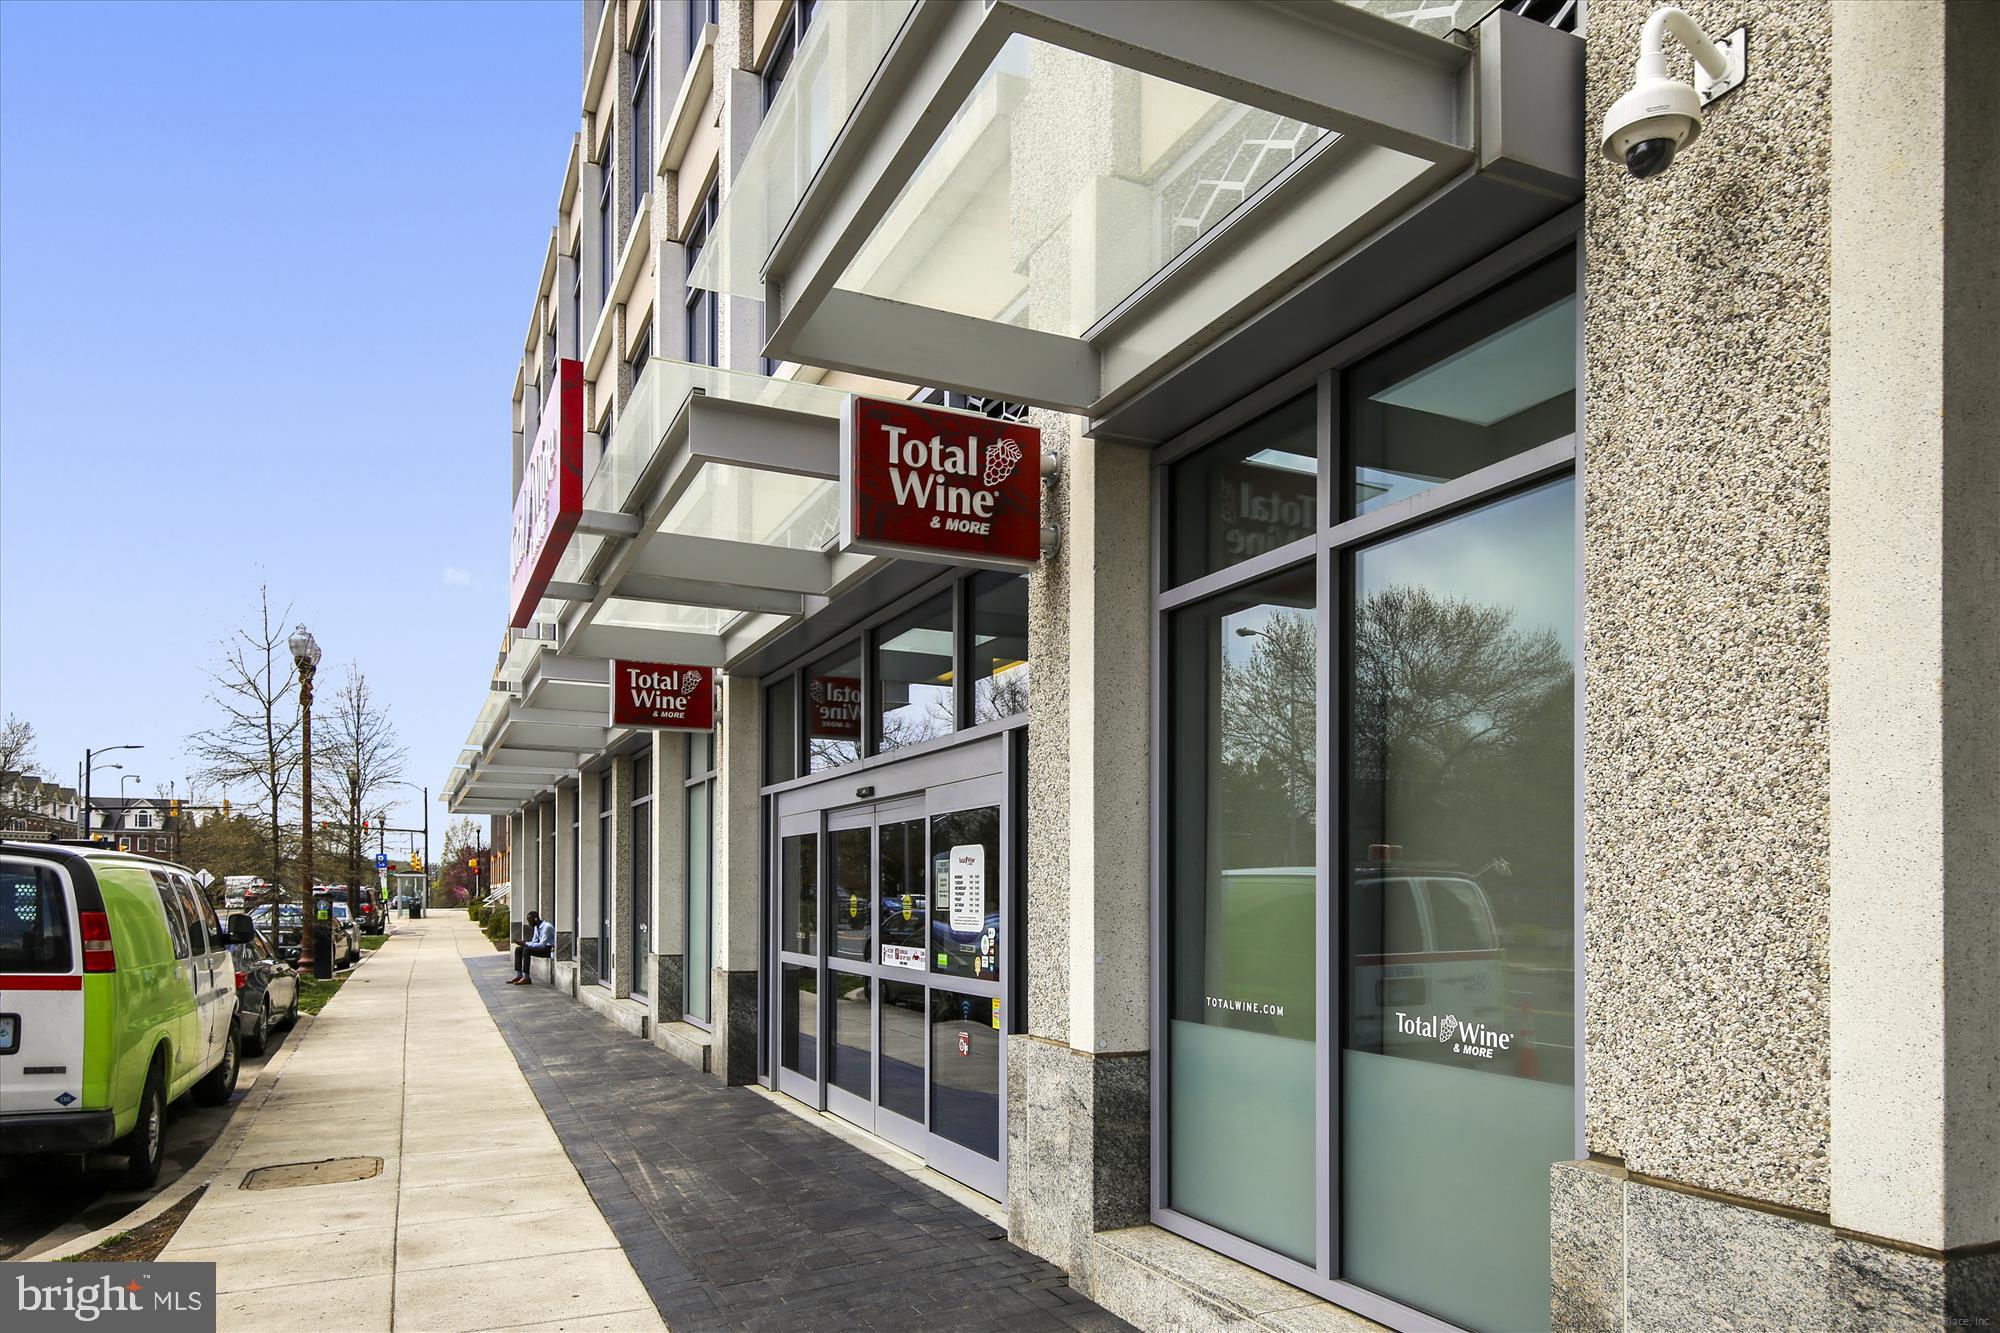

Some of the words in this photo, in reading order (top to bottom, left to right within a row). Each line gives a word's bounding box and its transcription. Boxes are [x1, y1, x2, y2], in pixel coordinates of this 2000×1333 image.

[880, 424, 978, 476] Total
[888, 467, 995, 518] Wine
[930, 516, 941, 529] &
[945, 518, 991, 536] MORE
[626, 668, 679, 691] Total
[630, 689, 688, 710] Wine
[660, 711, 686, 719] MORE
[1206, 996, 1284, 1017] TOTALWINE.COM
[1395, 1012, 1437, 1038] Total
[1458, 1021, 1511, 1050] Wine
[1453, 1043, 1461, 1053] &
[1462, 1044, 1494, 1059] MORE
